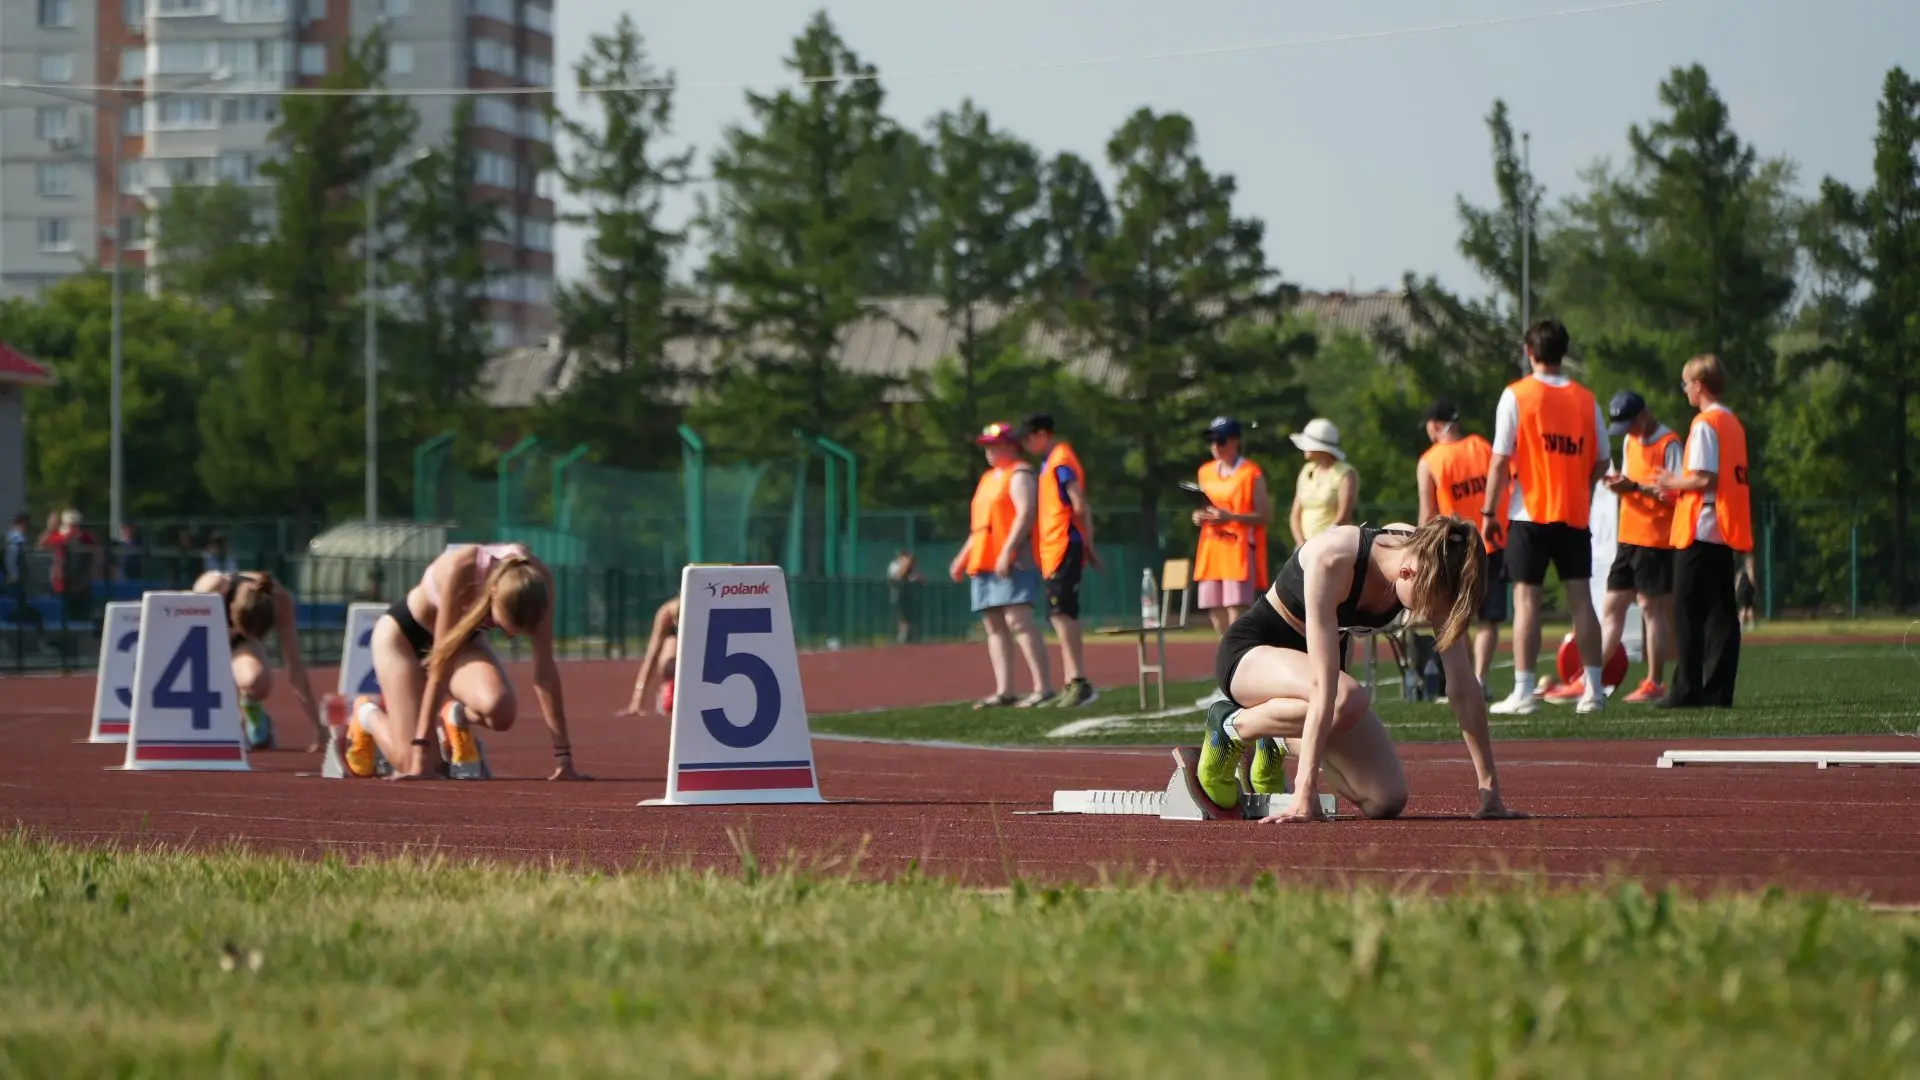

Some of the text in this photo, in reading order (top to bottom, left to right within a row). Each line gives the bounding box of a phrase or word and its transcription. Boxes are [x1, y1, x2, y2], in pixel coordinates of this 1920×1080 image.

[721, 581, 770, 598] polanik
[151, 625, 222, 730] 4
[701, 608, 781, 748] 5
